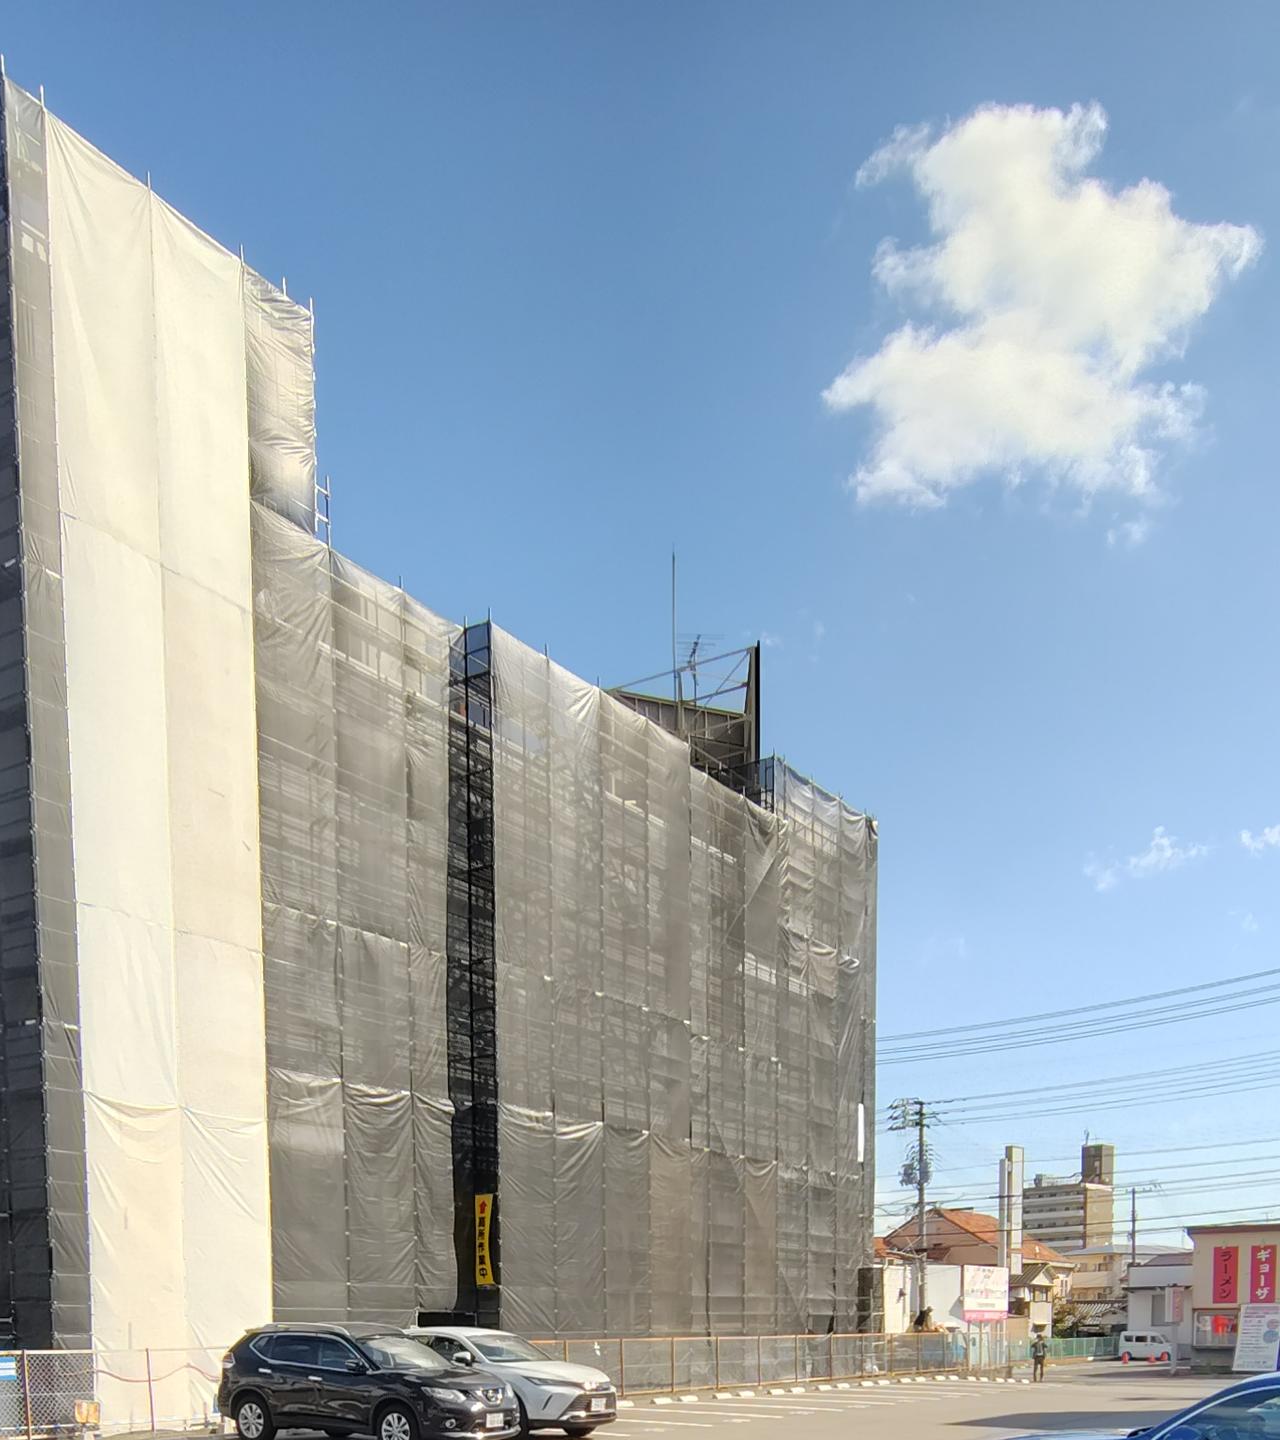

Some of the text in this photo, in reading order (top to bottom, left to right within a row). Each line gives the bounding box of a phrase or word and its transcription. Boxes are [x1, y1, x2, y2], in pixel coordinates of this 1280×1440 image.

[1220, 1250, 1233, 1299] ラーメン
[1255, 1248, 1272, 1300] ギョーザ
